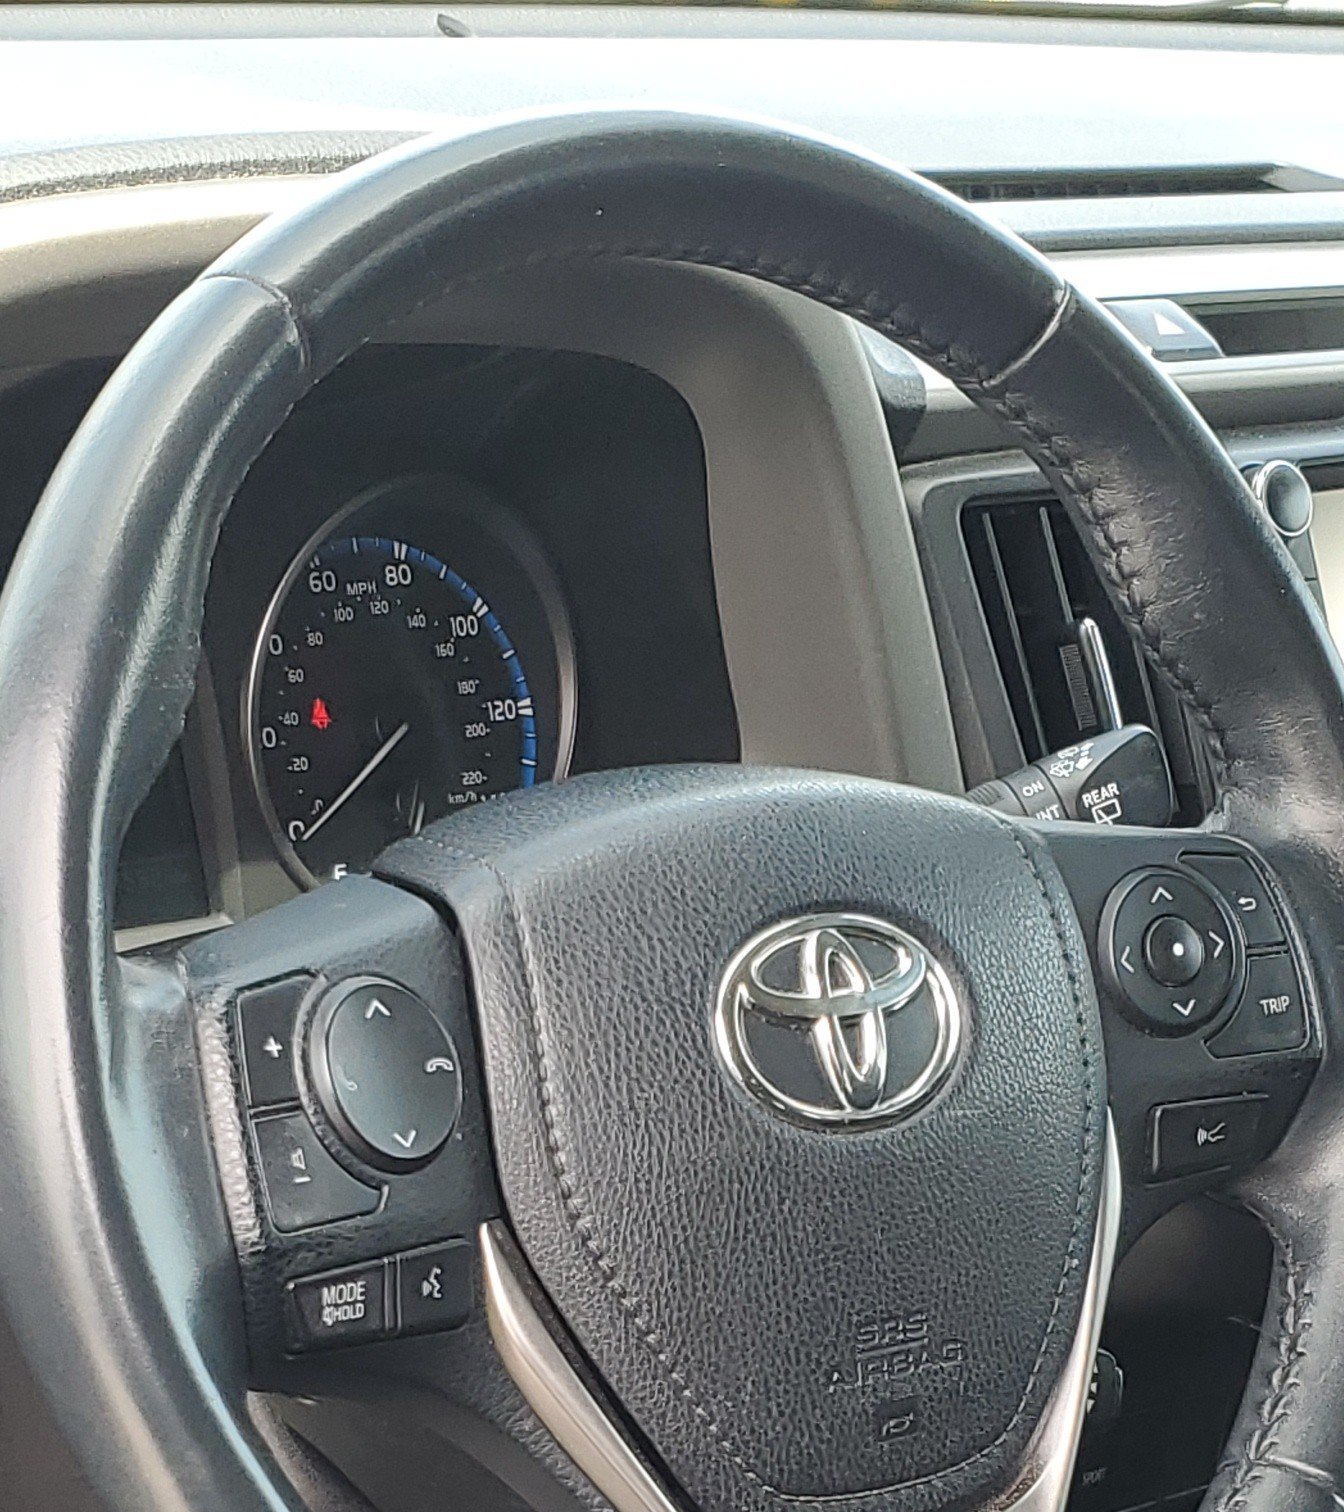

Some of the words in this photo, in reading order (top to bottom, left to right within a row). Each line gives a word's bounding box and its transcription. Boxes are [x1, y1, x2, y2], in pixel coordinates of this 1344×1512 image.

[308, 570, 337, 593] 60
[384, 563, 413, 587] 80
[346, 580, 378, 597] MPH
[332, 606, 354, 623] 100
[368, 600, 390, 616] 120
[406, 613, 427, 629] 140
[449, 615, 480, 638] 100
[306, 631, 324, 647] 80
[434, 641, 455, 658] 160
[286, 667, 305, 683] 60
[456, 680, 477, 695] 180
[487, 698, 517, 722] 120
[281, 711, 300, 727] 40
[464, 723, 486, 738] 200
[291, 755, 309, 772] 20
[460, 771, 483, 786] 220
[1022, 779, 1045, 798] ON
[1082, 781, 1120, 808] REAR
[448, 791, 477, 804] km/h
[1259, 995, 1291, 1016] TRIP
[321, 1280, 367, 1307] MODE
[333, 1302, 366, 1322] HOLD
